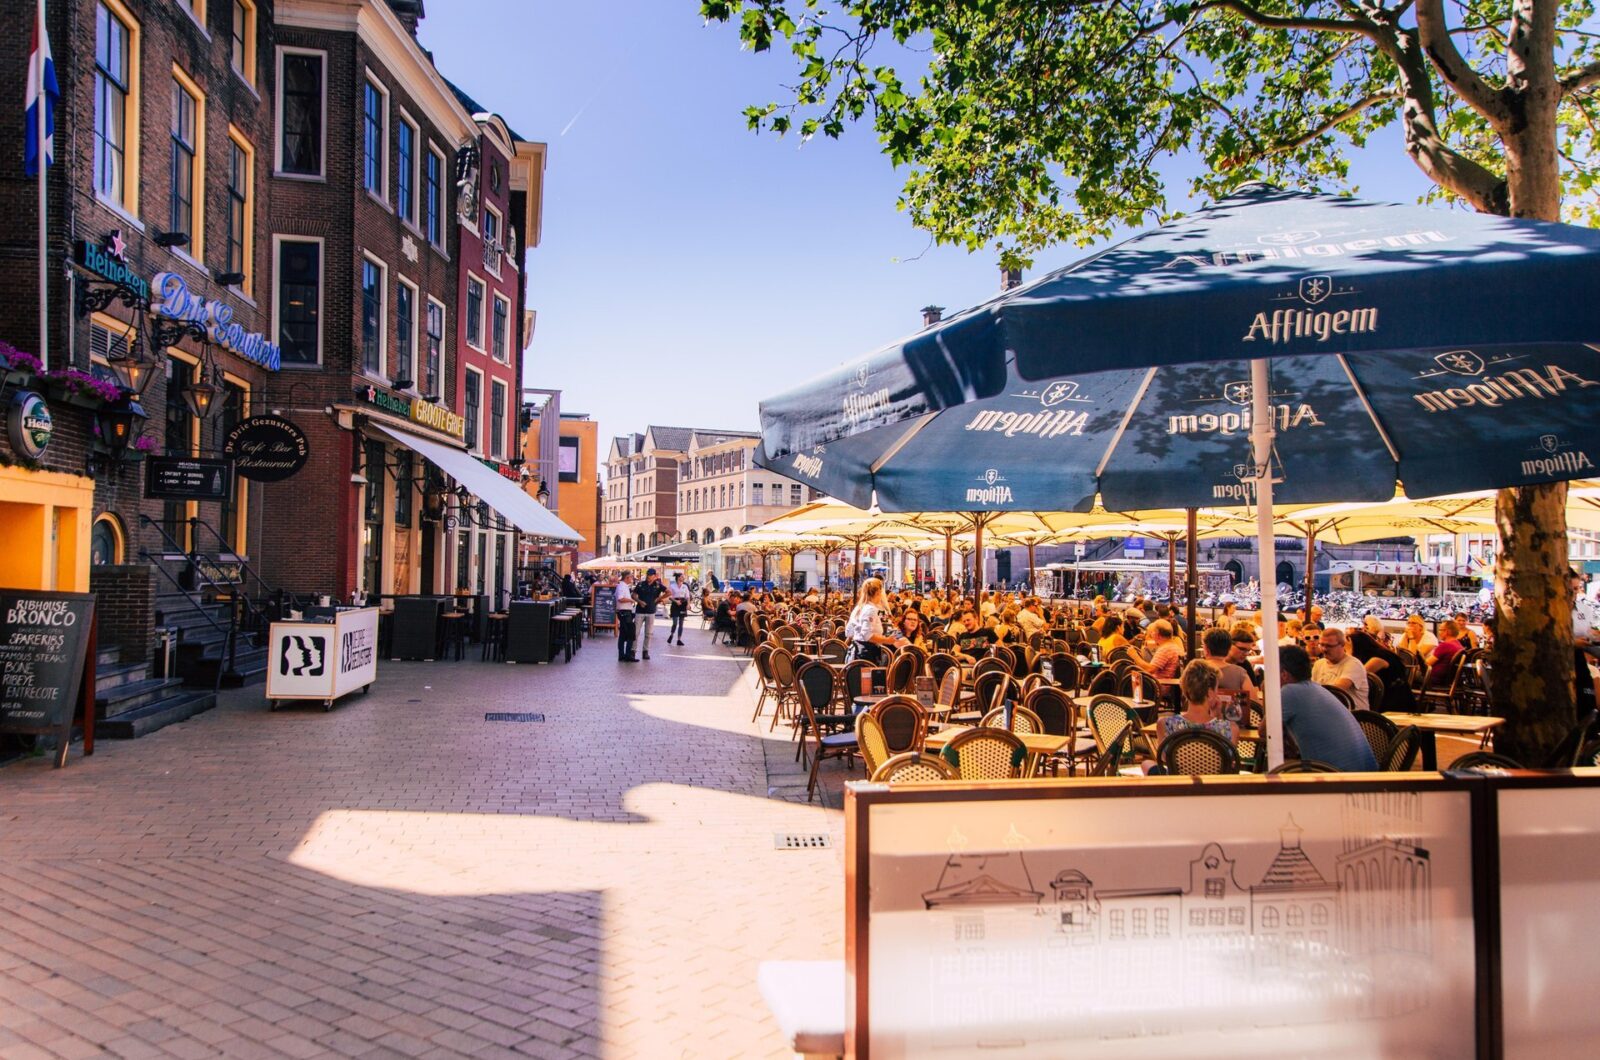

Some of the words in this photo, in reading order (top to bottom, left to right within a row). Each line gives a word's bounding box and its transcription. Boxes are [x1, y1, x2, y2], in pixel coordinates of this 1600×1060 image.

[1152, 230, 1457, 269] Affligem
[84, 240, 148, 299] Heineken
[154, 272, 208, 321] Drie
[1242, 307, 1379, 344] Affligem
[416, 400, 446, 430] GROOTE
[842, 387, 890, 426] Affligem
[229, 423, 250, 440] Drie
[251, 418, 298, 438] Gezusters
[225, 441, 234, 454] De
[271, 441, 293, 453] Bar
[296, 437, 307, 457] Pub
[237, 457, 297, 468] Restaurant
[16, 600, 69, 612] RIBHOUSE
[7, 609, 76, 626] BRONCO
[9, 633, 64, 646] SPARERIBS
[34, 653, 67, 663] STEAKS
[2, 674, 35, 687] RIBEYE
[6, 687, 60, 700] ENTRECOTE
